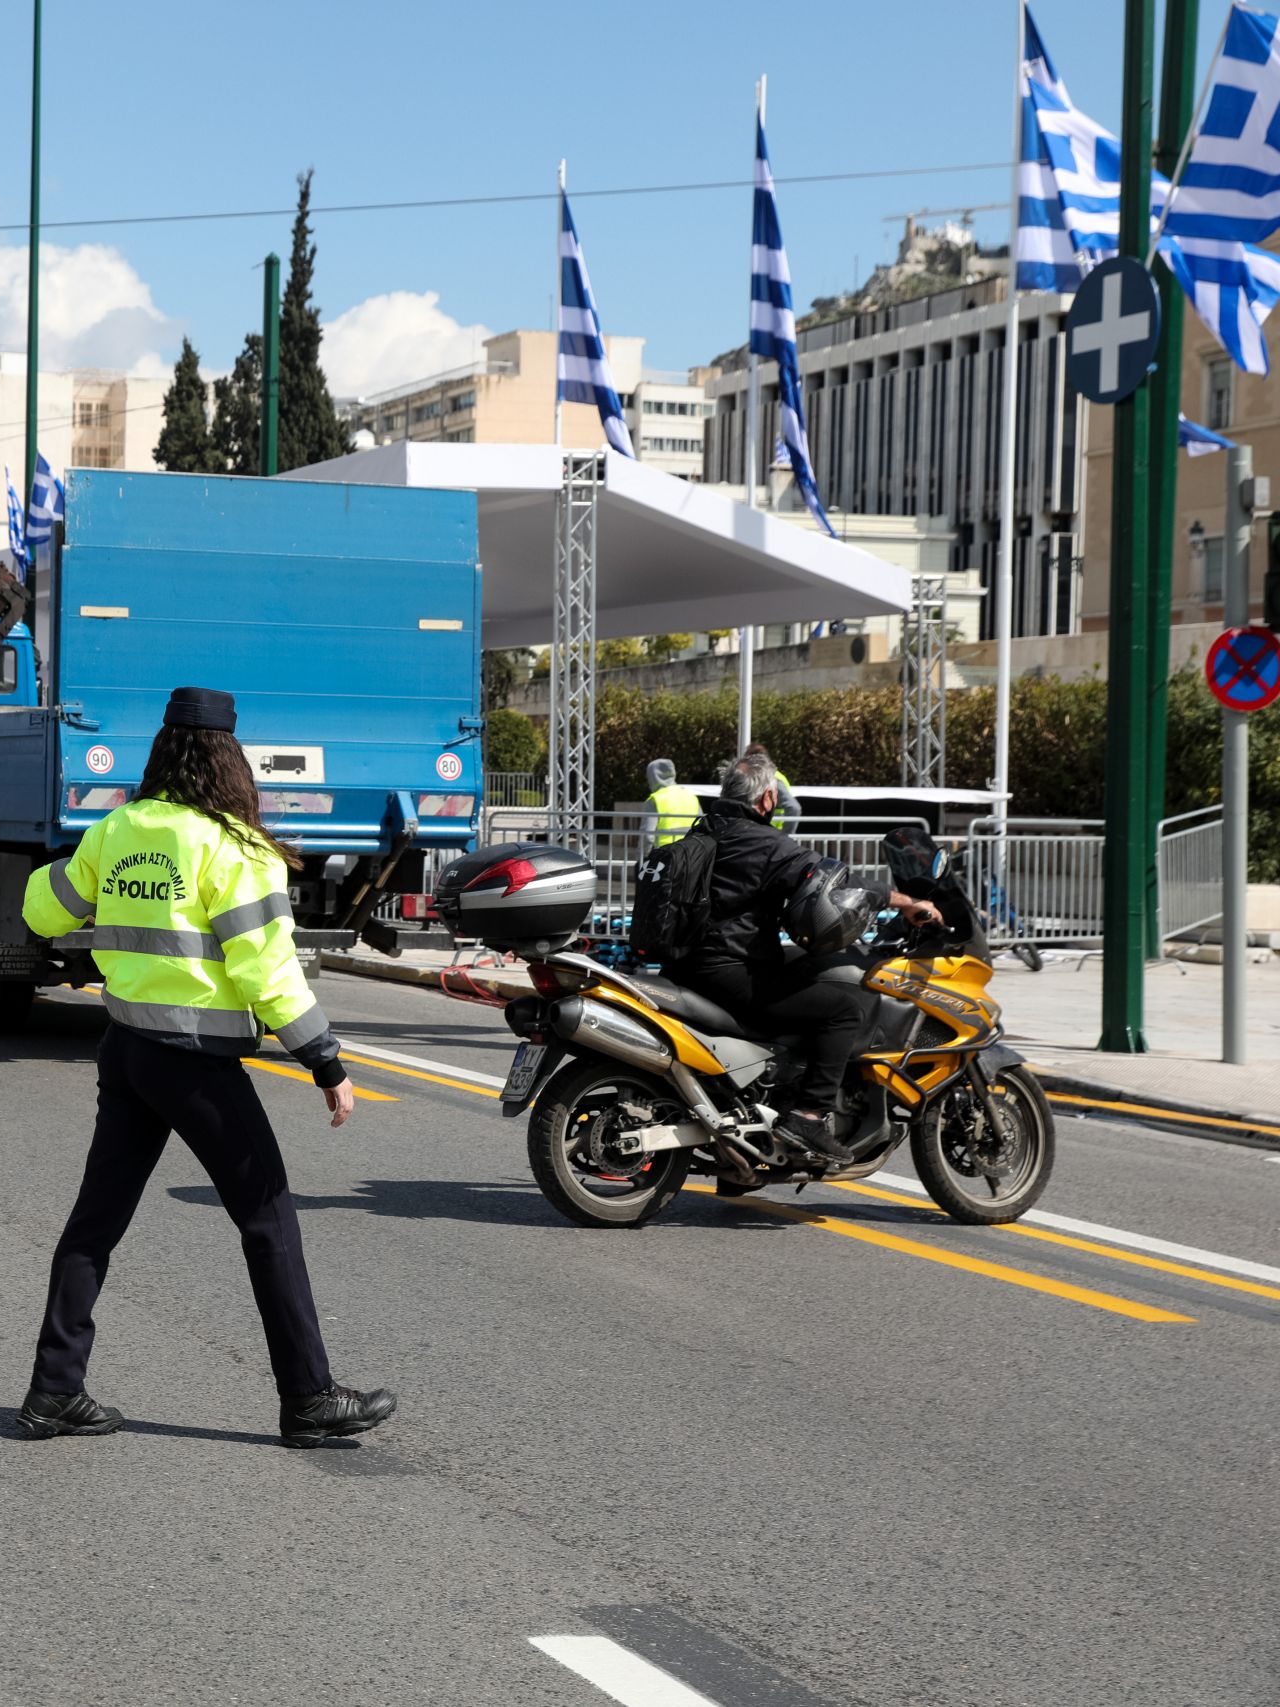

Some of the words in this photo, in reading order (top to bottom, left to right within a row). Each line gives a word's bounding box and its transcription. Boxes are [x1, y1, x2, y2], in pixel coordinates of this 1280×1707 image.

[92, 753, 108, 767] 90
[442, 760, 456, 773] 80
[102, 852, 147, 895] ΕΛΛΗΝΙΚΗ
[118, 879, 170, 901] POLICE
